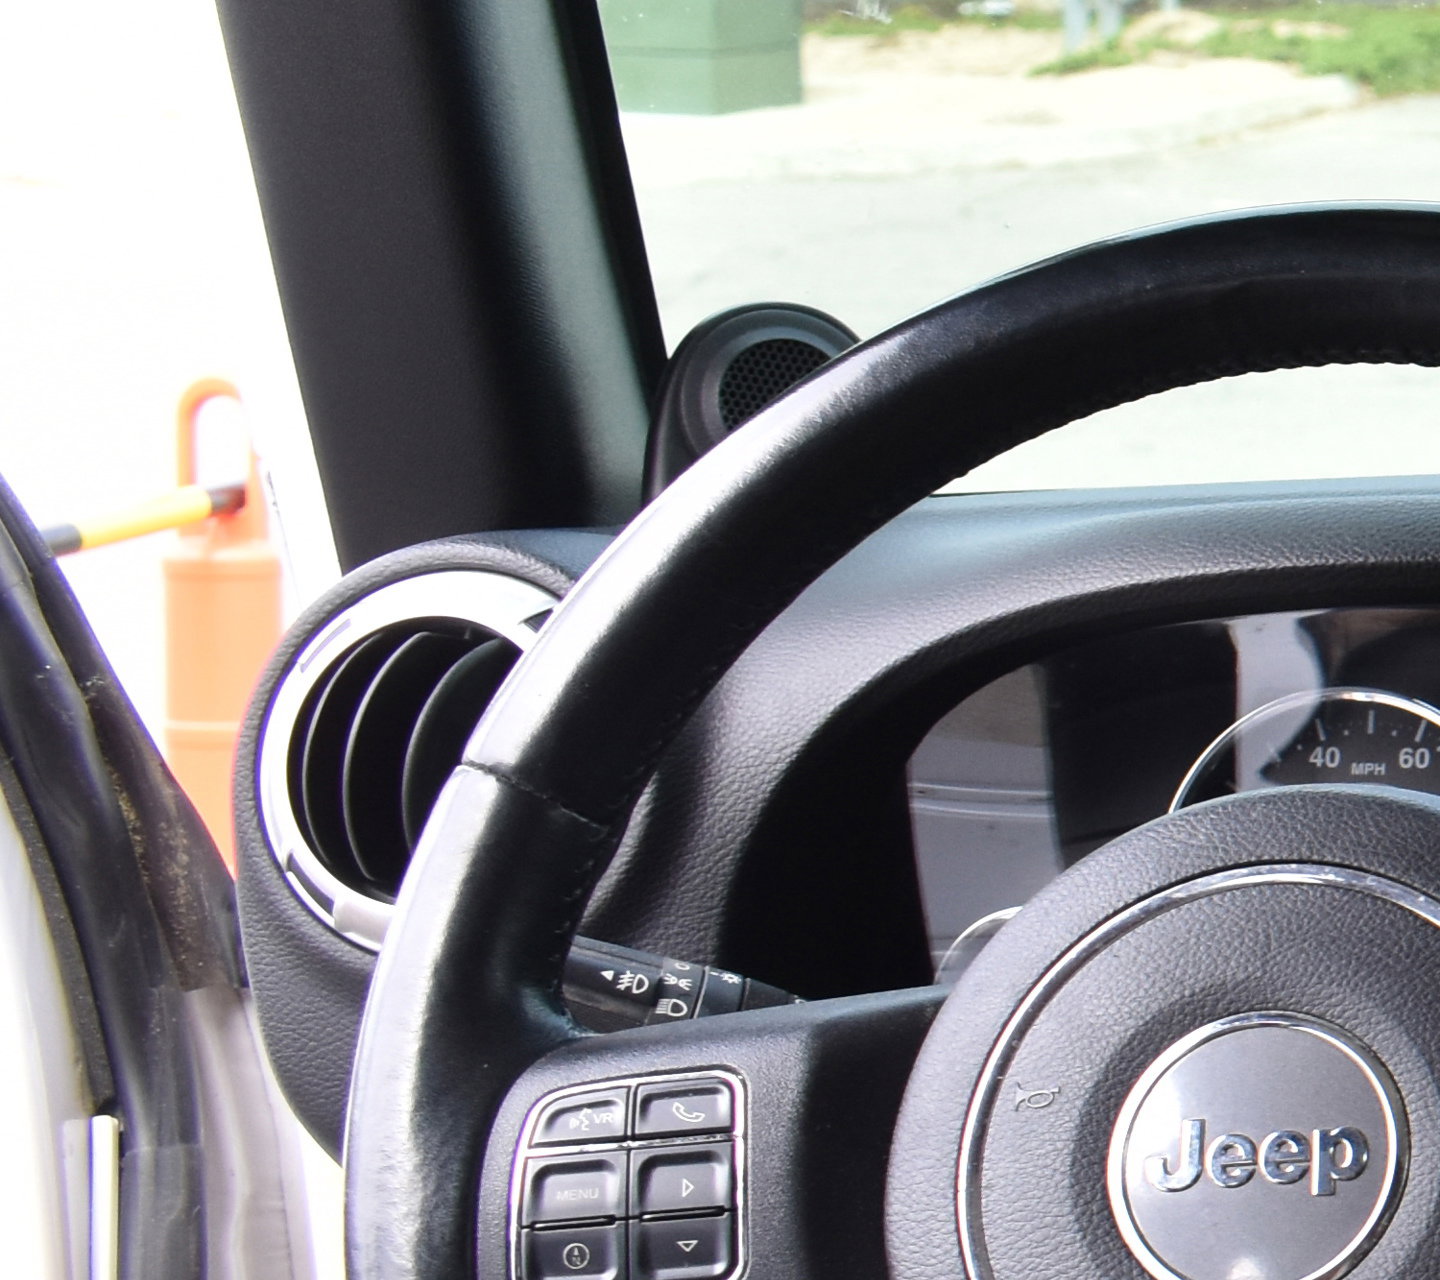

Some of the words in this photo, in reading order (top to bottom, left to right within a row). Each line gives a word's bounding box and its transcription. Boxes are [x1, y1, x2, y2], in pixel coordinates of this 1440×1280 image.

[1309, 747, 1341, 770] 40
[1398, 747, 1431, 770] 60
[1350, 761, 1387, 776] MPH
[591, 1111, 613, 1125] VR
[1144, 1118, 1369, 1197] Jeep
[556, 1187, 599, 1202] MENU
